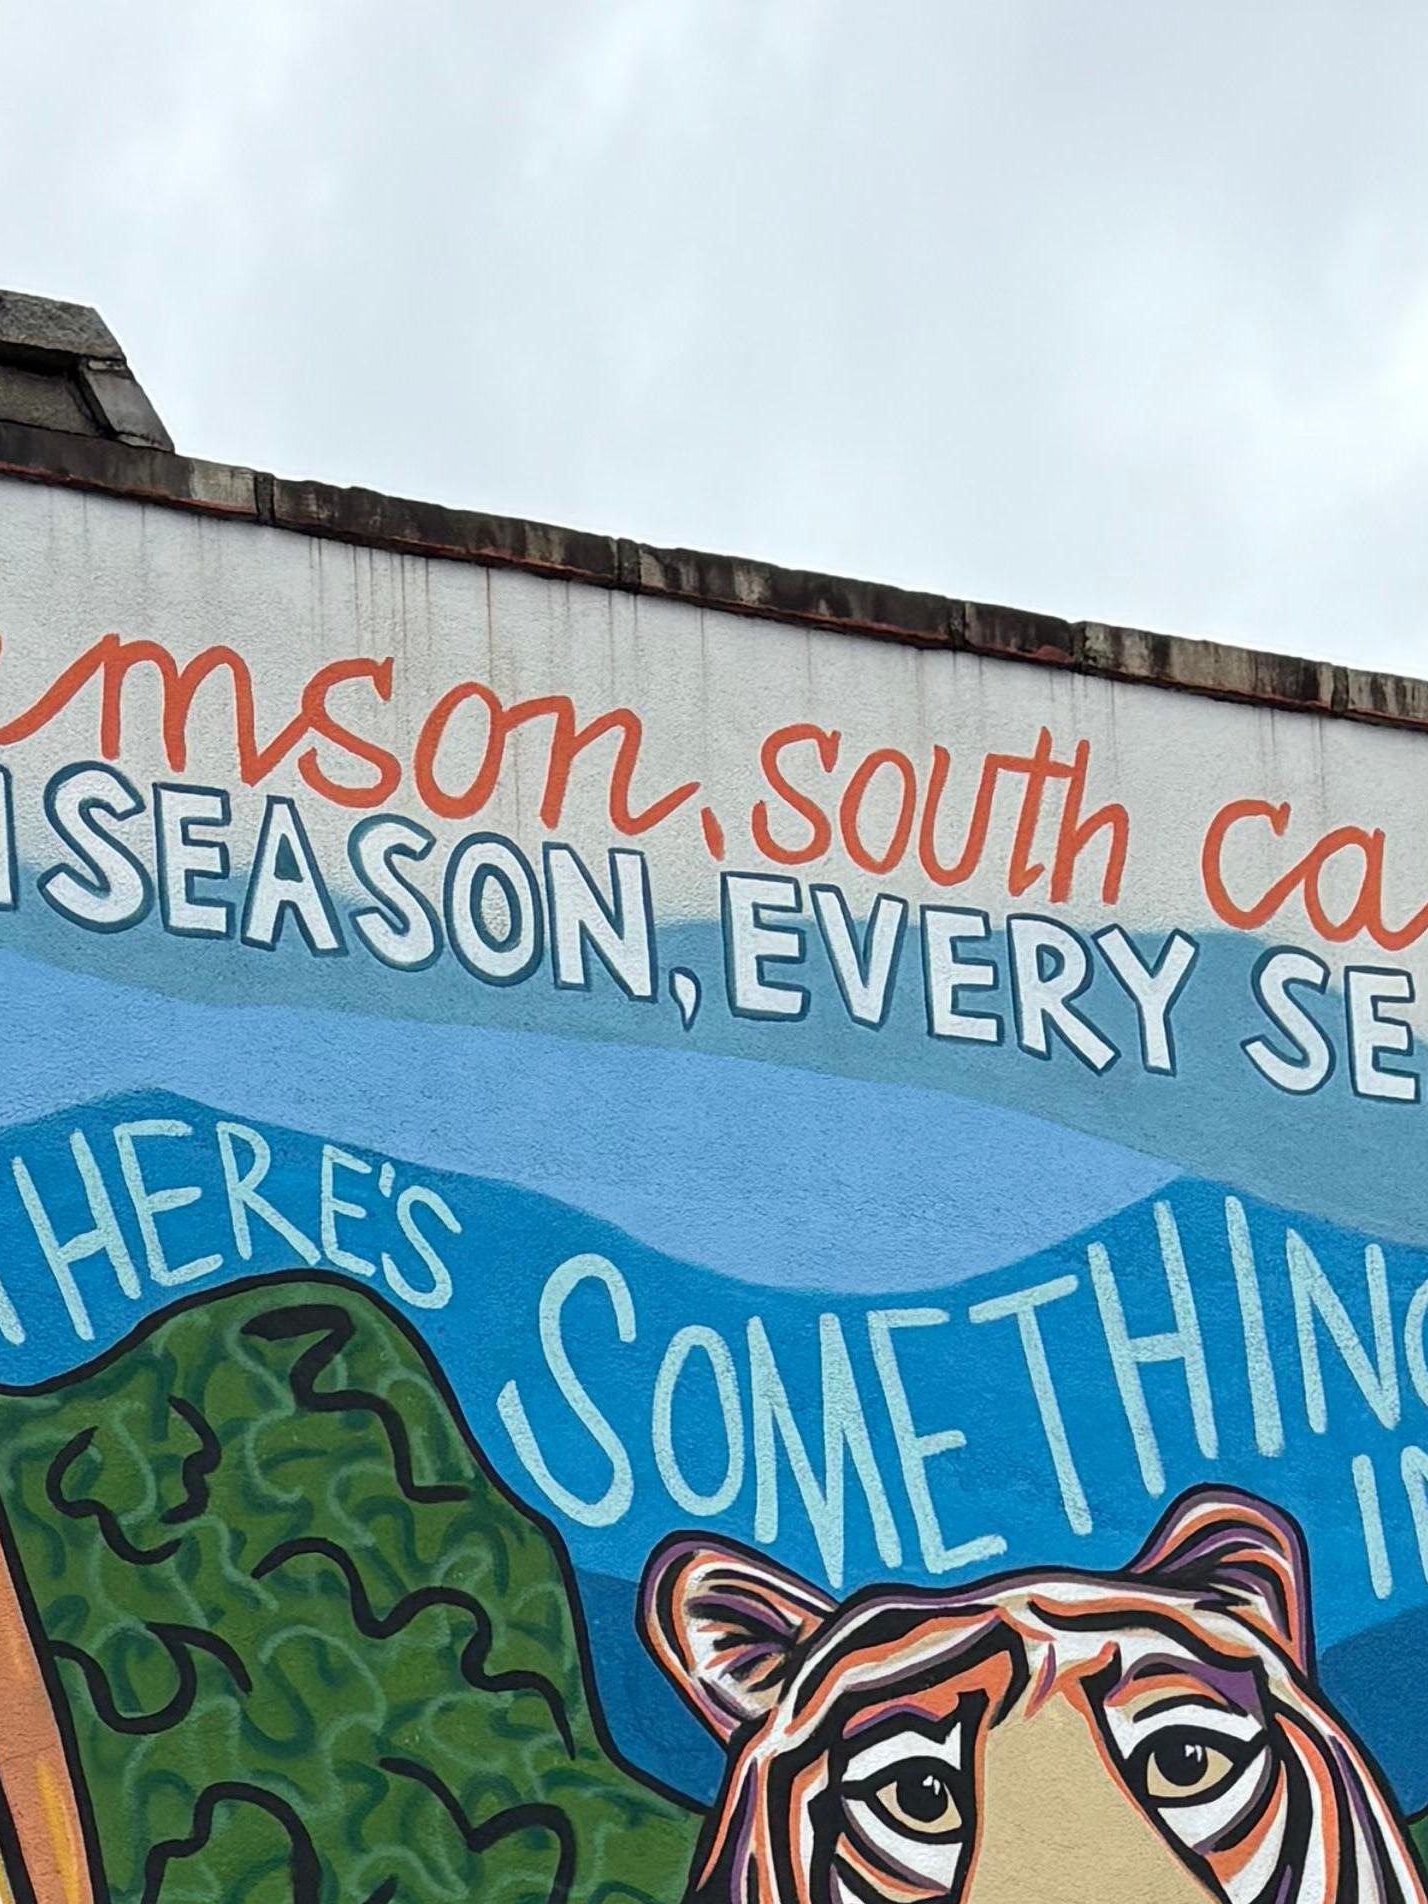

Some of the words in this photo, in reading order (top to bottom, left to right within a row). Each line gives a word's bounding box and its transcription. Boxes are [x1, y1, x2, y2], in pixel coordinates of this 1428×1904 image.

[37, 759, 702, 1031] SEASON,
[719, 869, 1200, 1077] EVERY
[752, 722, 1129, 905] south
